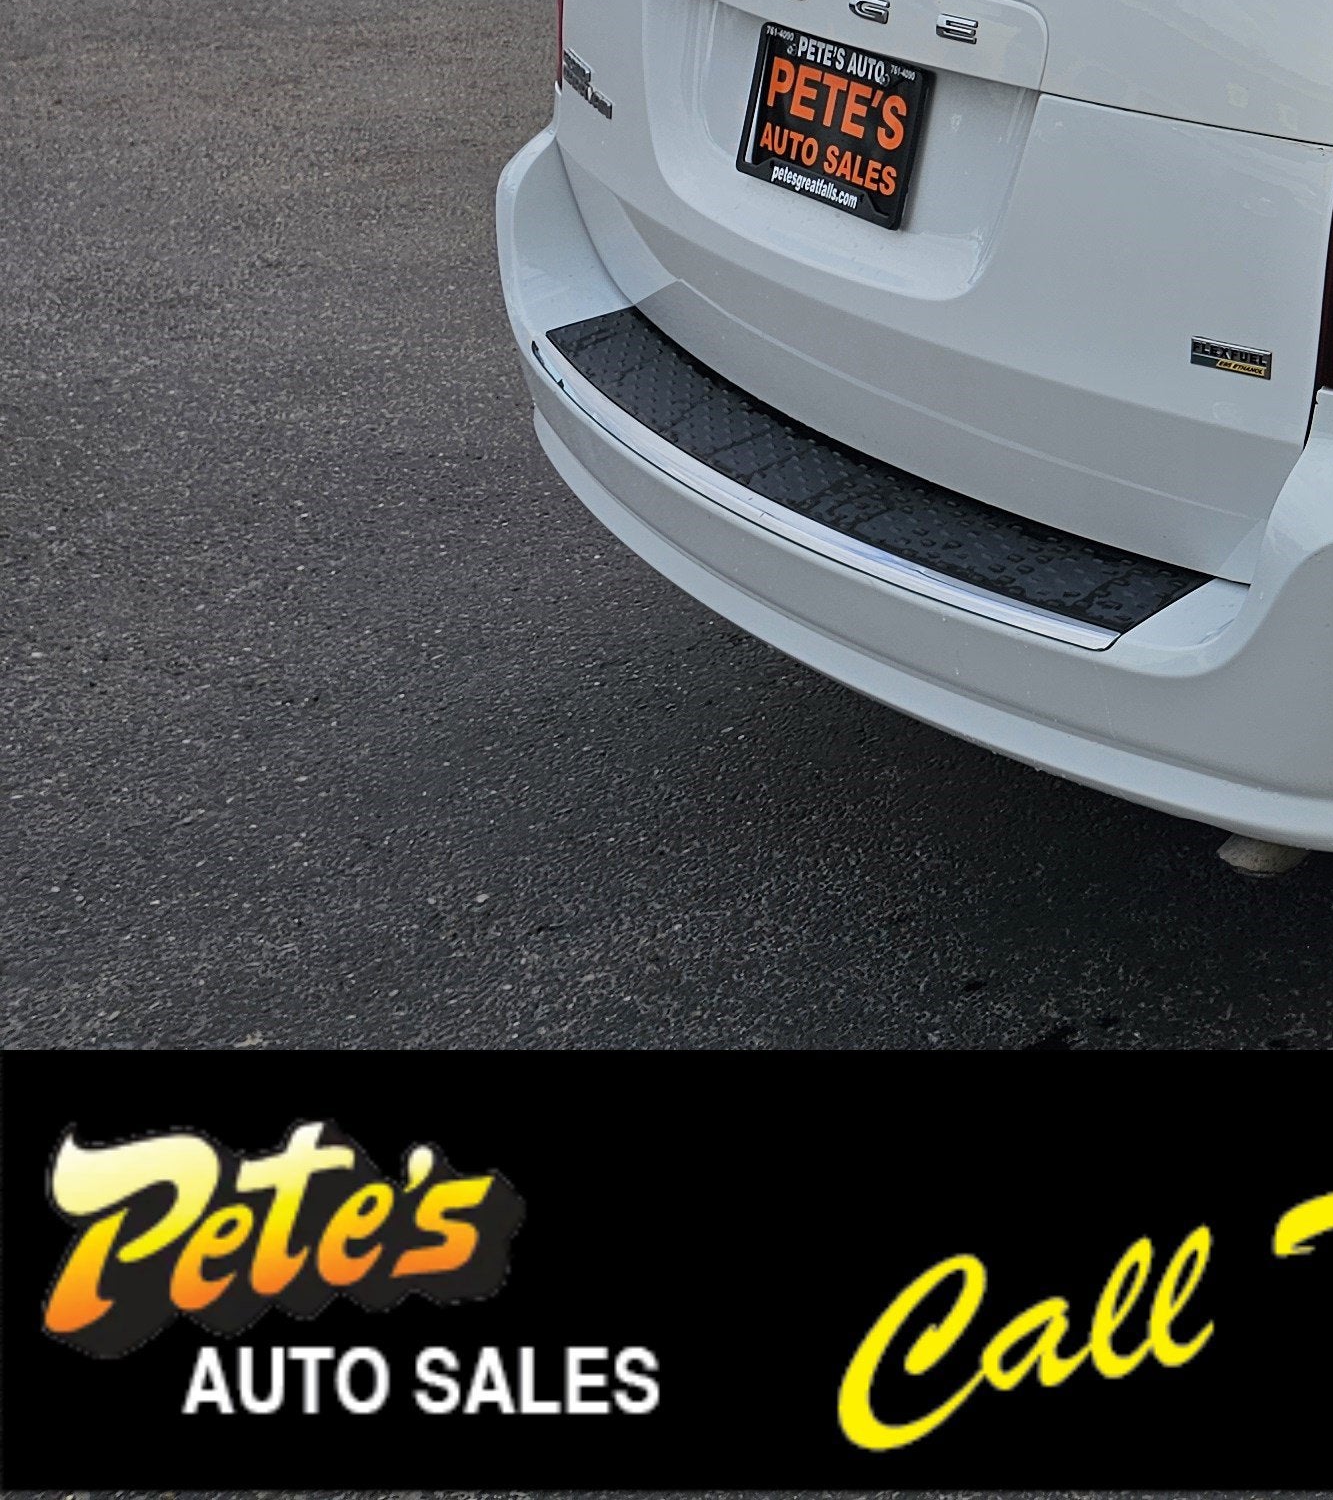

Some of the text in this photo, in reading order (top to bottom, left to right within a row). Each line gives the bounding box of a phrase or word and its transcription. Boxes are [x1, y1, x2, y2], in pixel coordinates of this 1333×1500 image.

[797, 35, 886, 85] PETE'S AUTO
[766, 56, 908, 151] PETE'S
[759, 122, 898, 196] AUTO SALES
[770, 164, 859, 210] petesgreatfalls.com
[1232, 364, 1263, 375] ETHANOL
